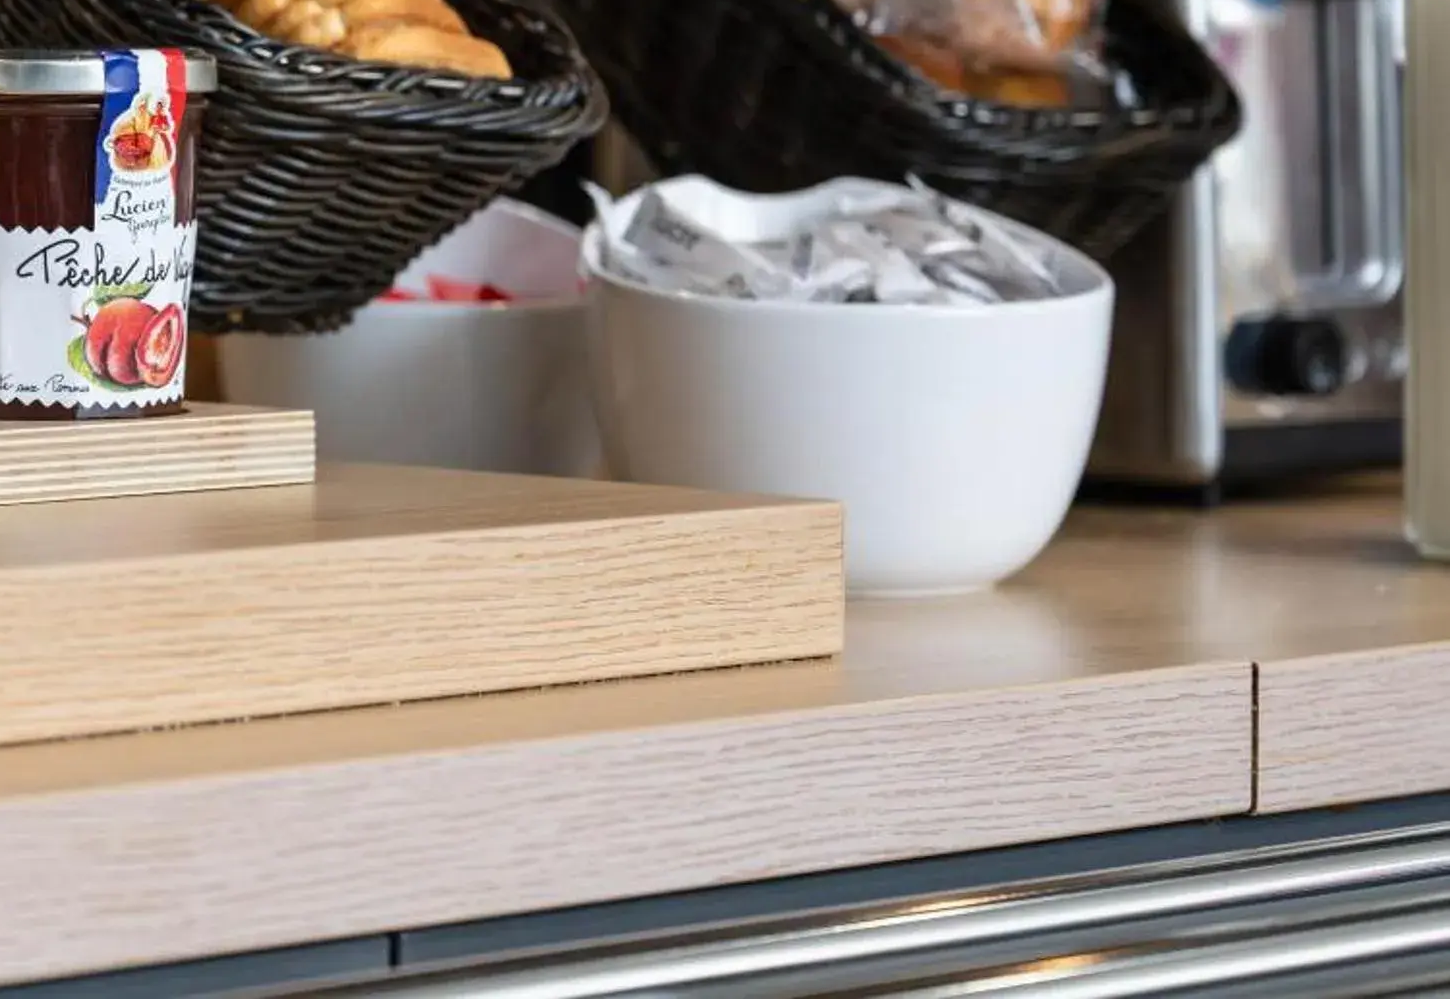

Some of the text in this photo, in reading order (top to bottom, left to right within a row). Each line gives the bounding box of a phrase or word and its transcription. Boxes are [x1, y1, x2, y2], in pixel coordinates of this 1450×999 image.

[101, 190, 167, 223] Lucien
[16, 238, 141, 287] Pêche
[141, 247, 171, 284] de
